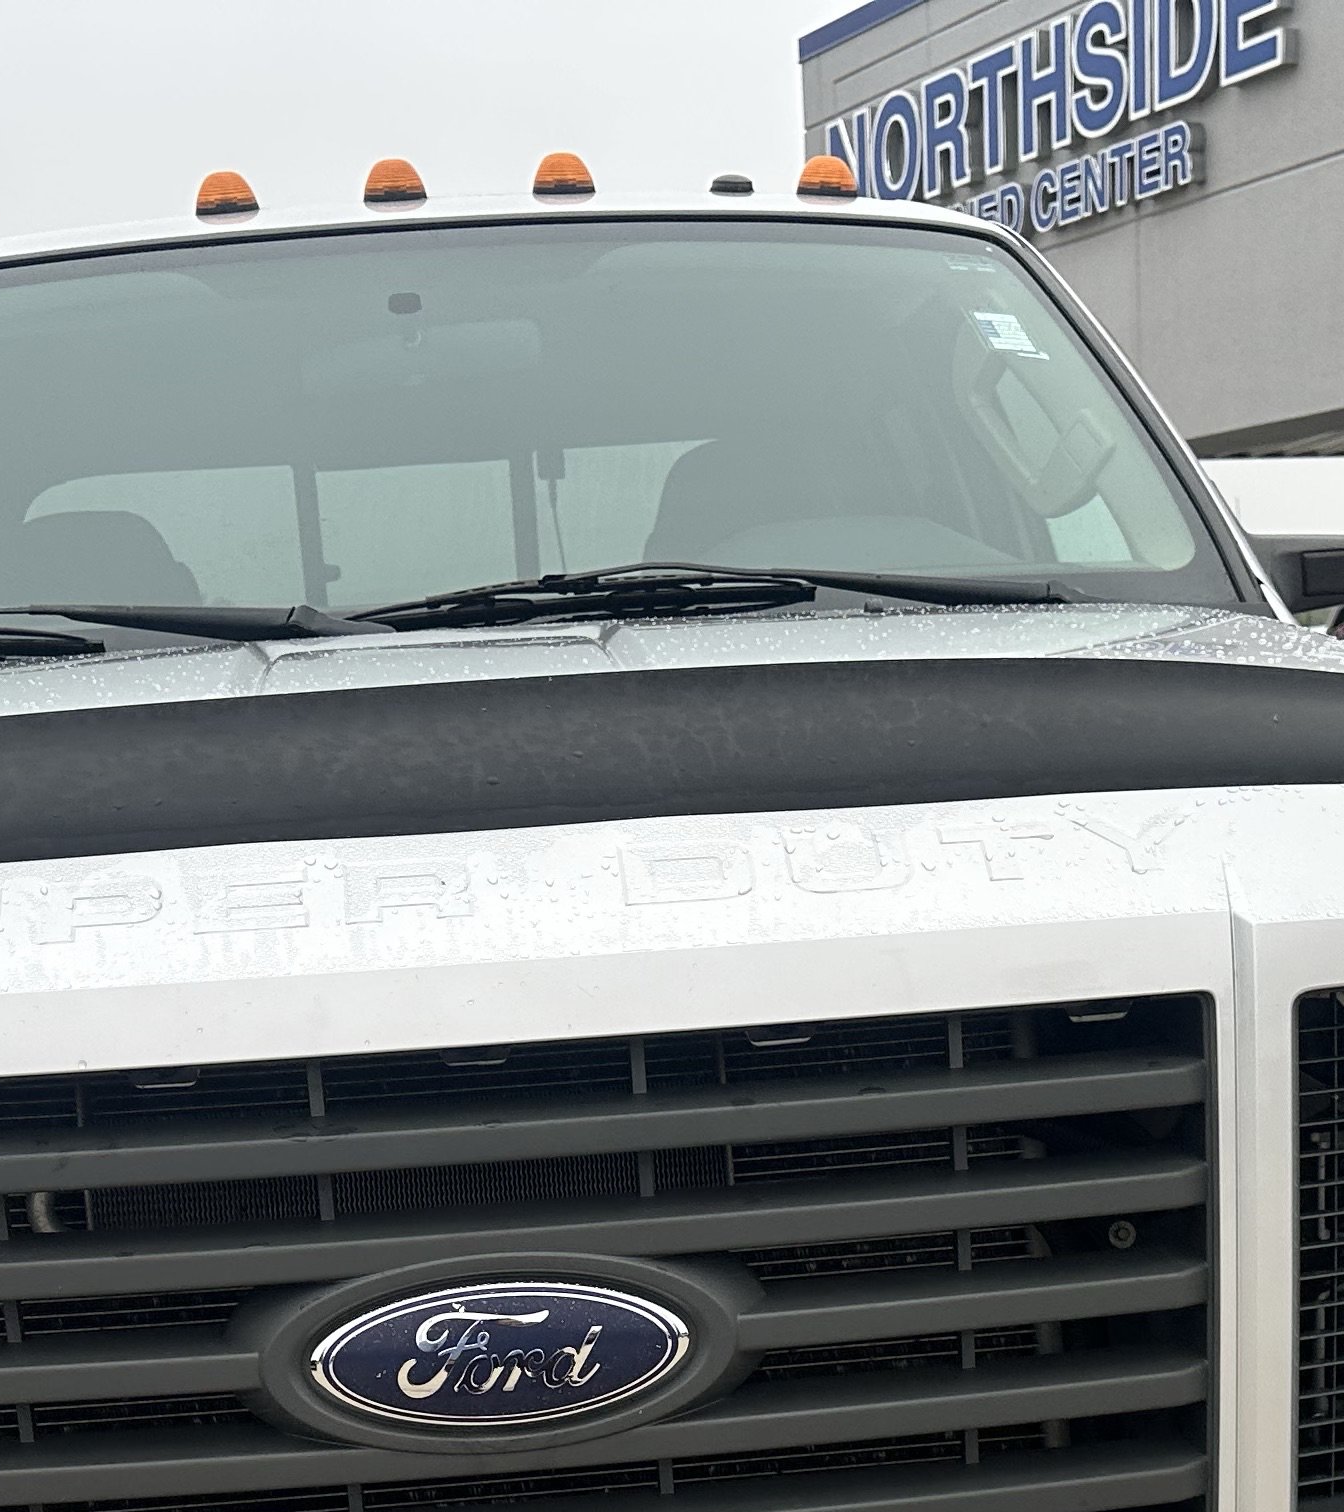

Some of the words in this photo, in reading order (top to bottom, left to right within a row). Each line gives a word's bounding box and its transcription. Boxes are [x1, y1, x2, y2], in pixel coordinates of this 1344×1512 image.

[825, 0, 1285, 201] NORTHSIDE
[1030, 119, 1193, 233] CENTER
[616, 805, 1198, 907] DUTY
[396, 1302, 603, 1400] Ford
